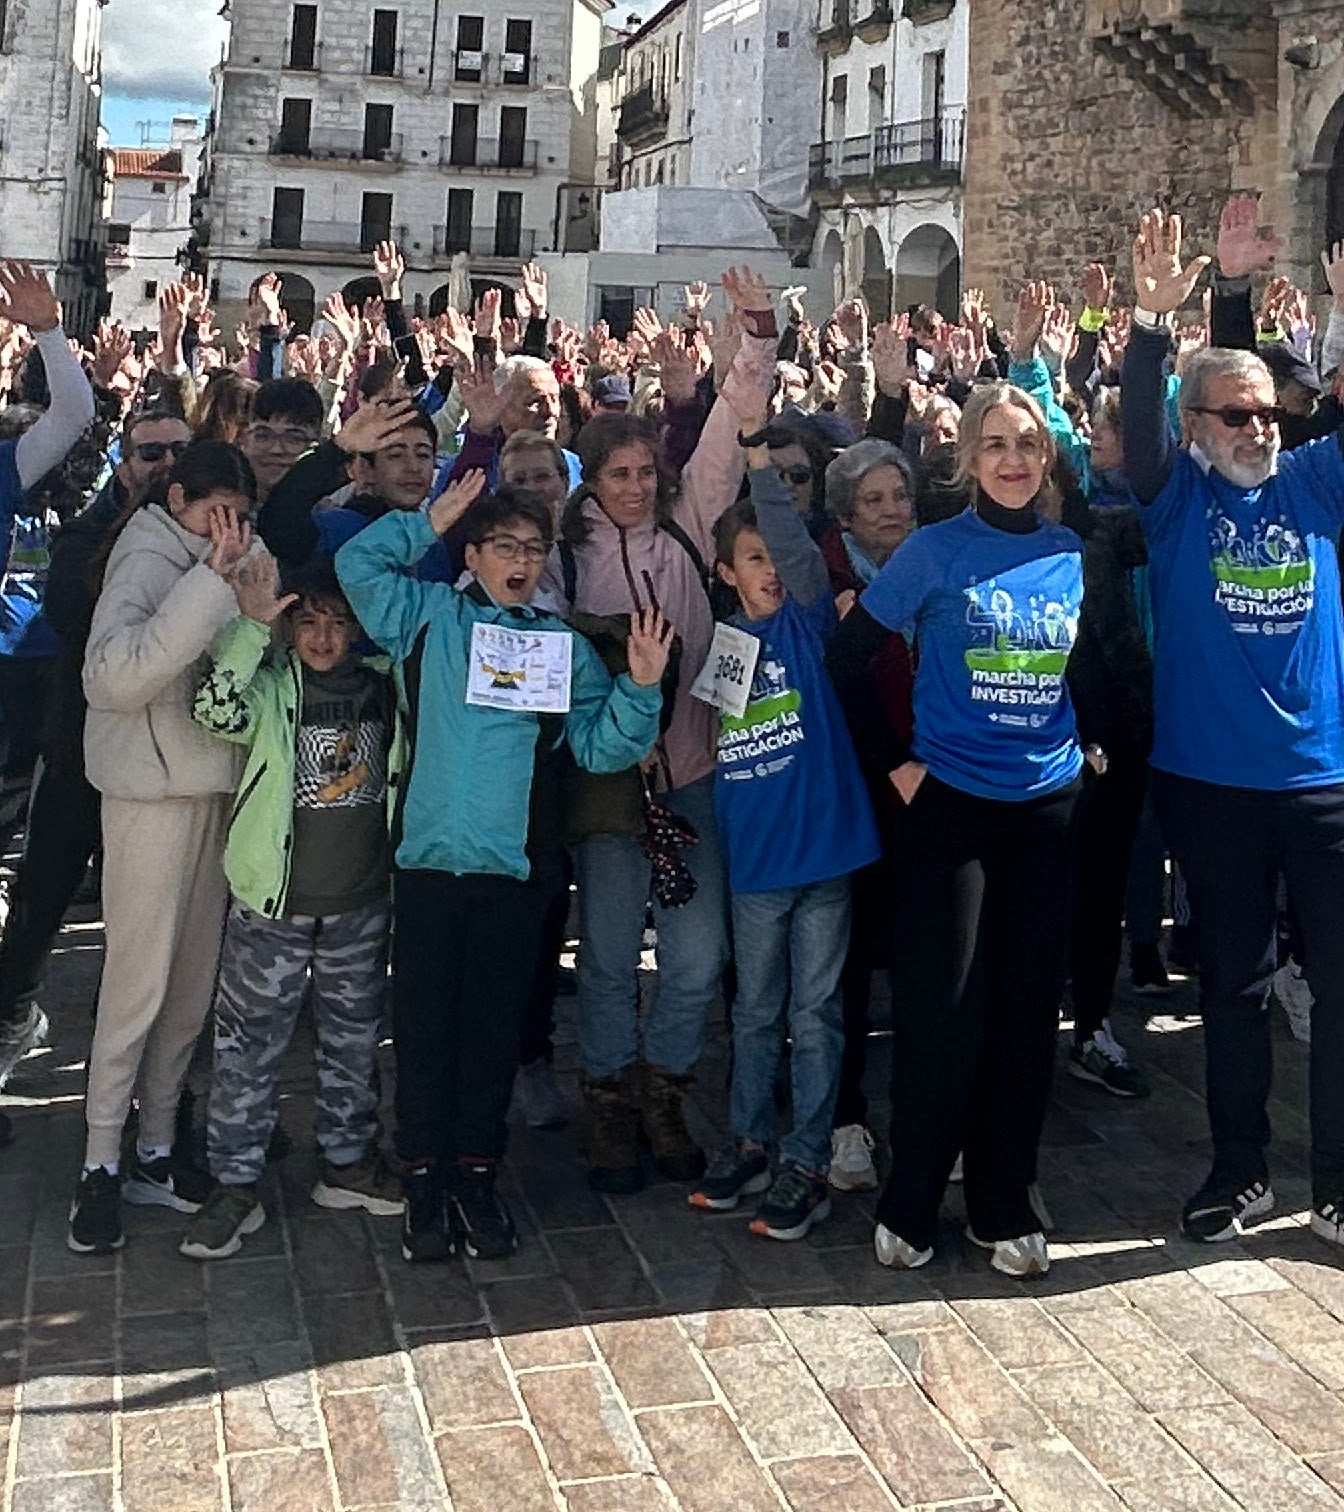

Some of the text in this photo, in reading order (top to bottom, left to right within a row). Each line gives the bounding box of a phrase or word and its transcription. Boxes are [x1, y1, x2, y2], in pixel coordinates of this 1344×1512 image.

[1268, 585, 1296, 603] por
[972, 668, 1036, 687] marcha
[751, 717, 779, 740] por
